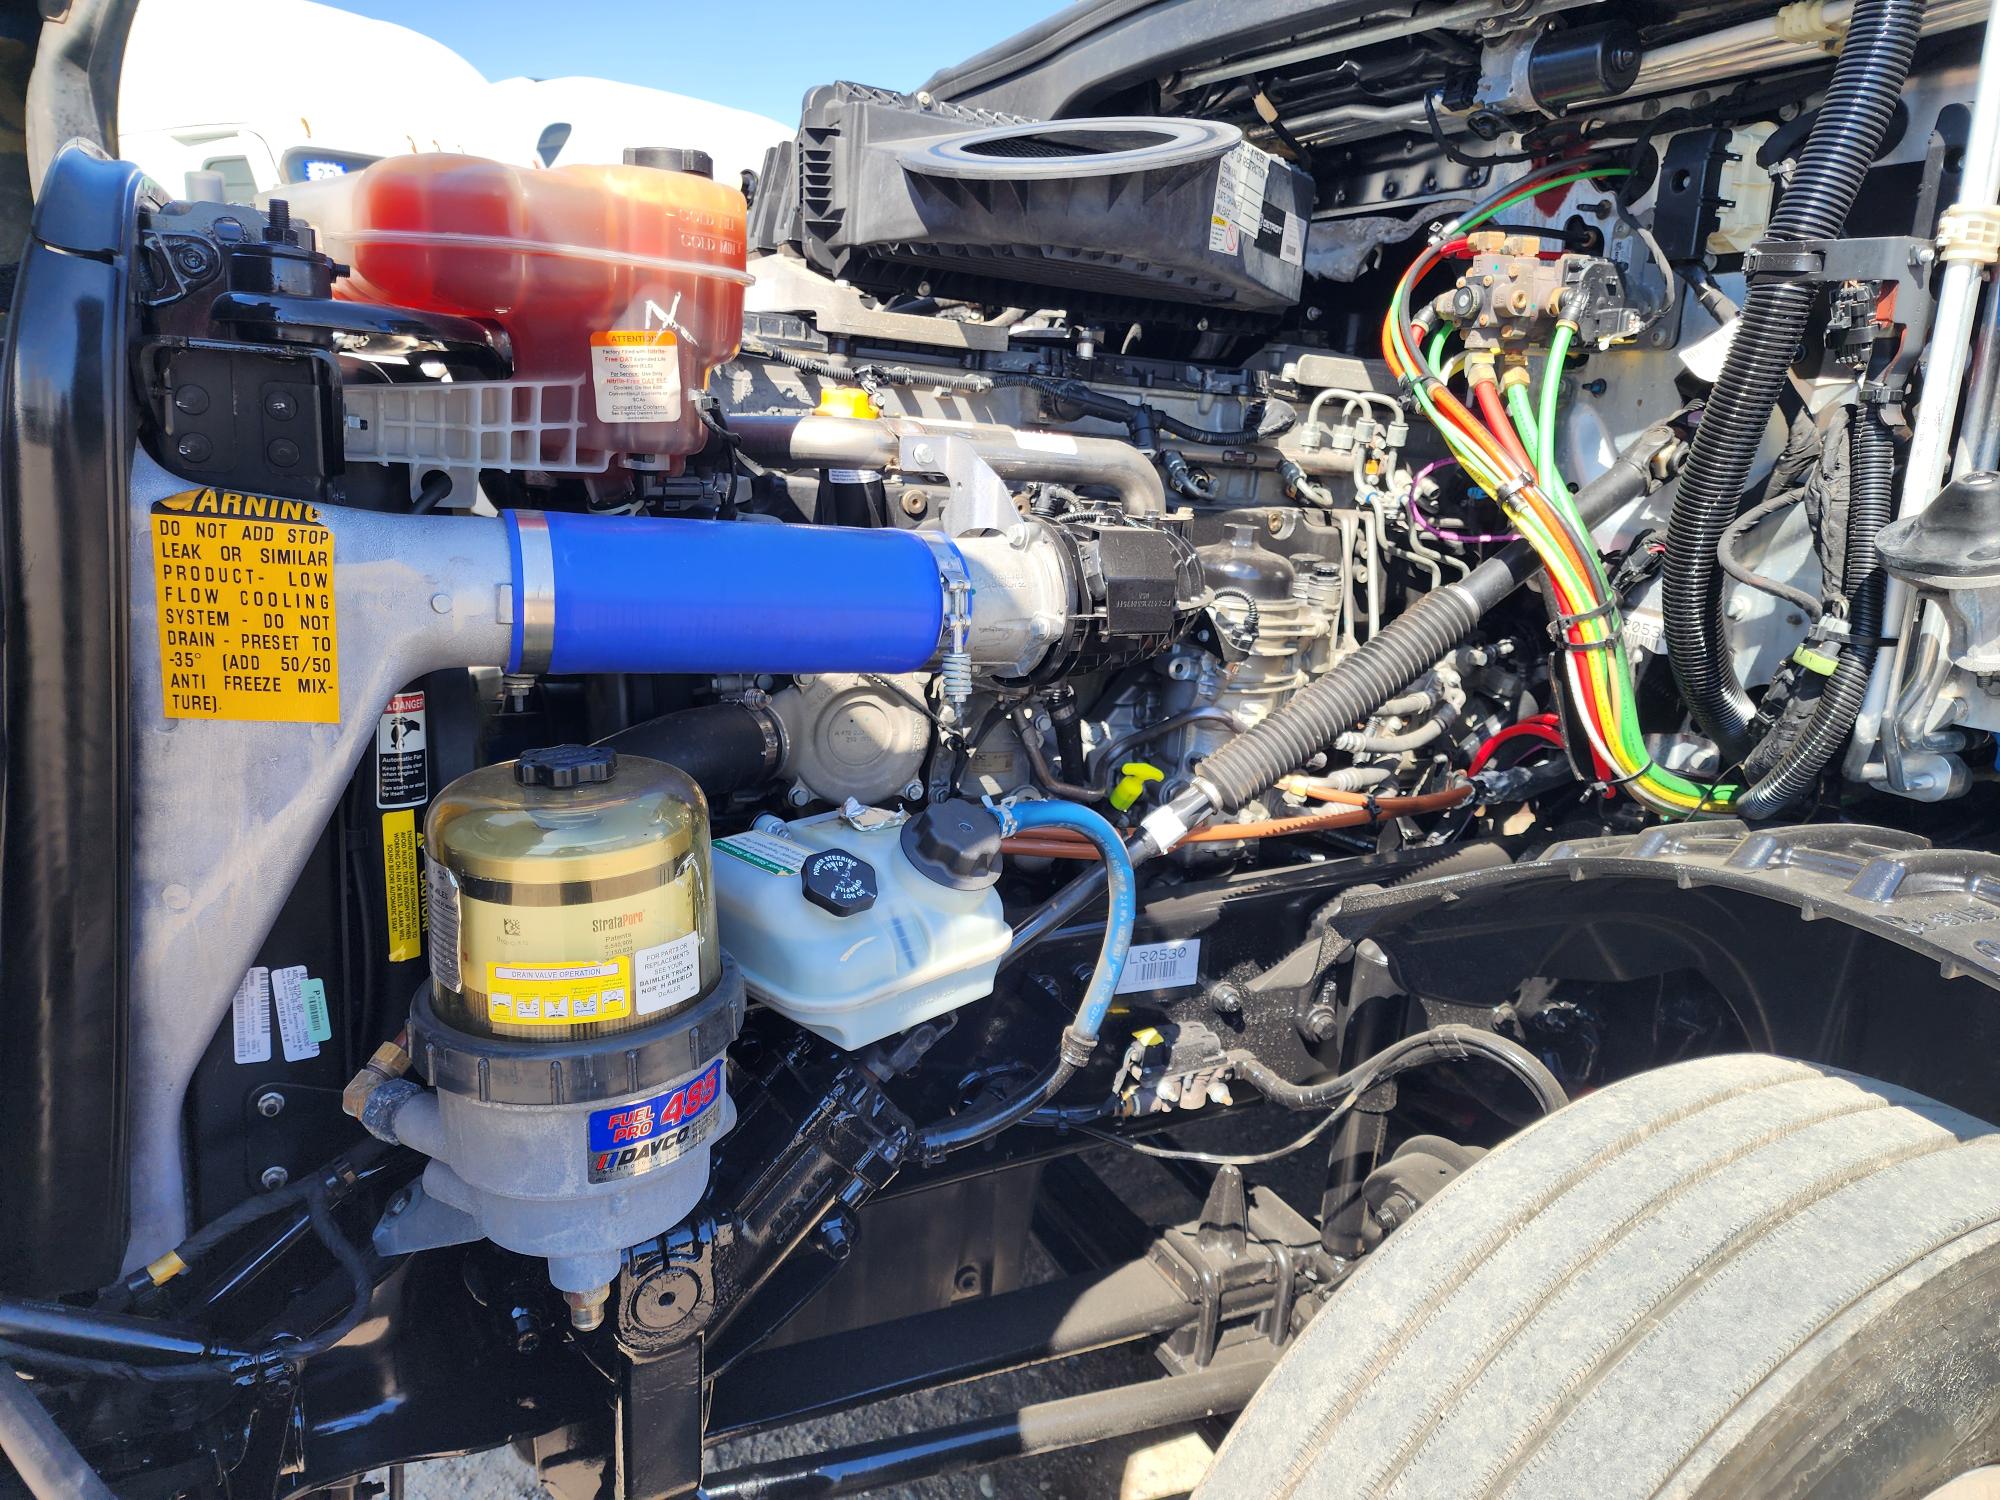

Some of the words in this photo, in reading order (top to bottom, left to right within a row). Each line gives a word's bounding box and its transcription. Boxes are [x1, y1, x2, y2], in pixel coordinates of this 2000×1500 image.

[680, 233, 716, 250] COLD
[160, 520, 180, 536] DO
[196, 522, 227, 539] NOT
[242, 527, 274, 542] ADD
[288, 529, 329, 545] STOP
[162, 542, 201, 559] LEAK
[221, 546, 241, 562] OR
[260, 549, 328, 567] SIMILAR
[164, 565, 264, 585] PRODUCT-
[288, 572, 328, 587] LOW
[165, 587, 219, 603] FLOW
[240, 592, 329, 610] COOLING
[166, 609, 229, 626] SYSTEM
[264, 614, 284, 629] DO
[300, 615, 330, 630] NOT
[167, 631, 215, 647] DRAIN
[242, 634, 299, 650] PRESET
[312, 637, 331, 651] TO
[281, 657, 331, 673] 50/50
[171, 674, 205, 689] ANTI
[224, 677, 281, 692] FREEZE
[298, 679, 334, 694] MIX-
[814, 858, 825, 876] POWER
[825, 856, 857, 867] STEERING
[835, 880, 862, 893] OVERFILL
[592, 911, 643, 933] StrataPore
[605, 933, 632, 942] Patents
[644, 950, 690, 970] REPLACEMENTS
[646, 952, 660, 961] FOR
[660, 946, 679, 958] PARTS
[1129, 947, 1186, 964] LR0530
[560, 968, 601, 977] OPERATION
[640, 971, 670, 987] DAIMLER
[672, 963, 694, 977] TRUCKS
[654, 966, 666, 975] SEE
[667, 960, 682, 971] YOUR
[667, 973, 693, 986] AMERICA
[660, 1068, 717, 1126] 485
[608, 1105, 656, 1130] FUEL
[613, 1120, 653, 1143] PRO
[618, 1126, 690, 1166] DAVCO
